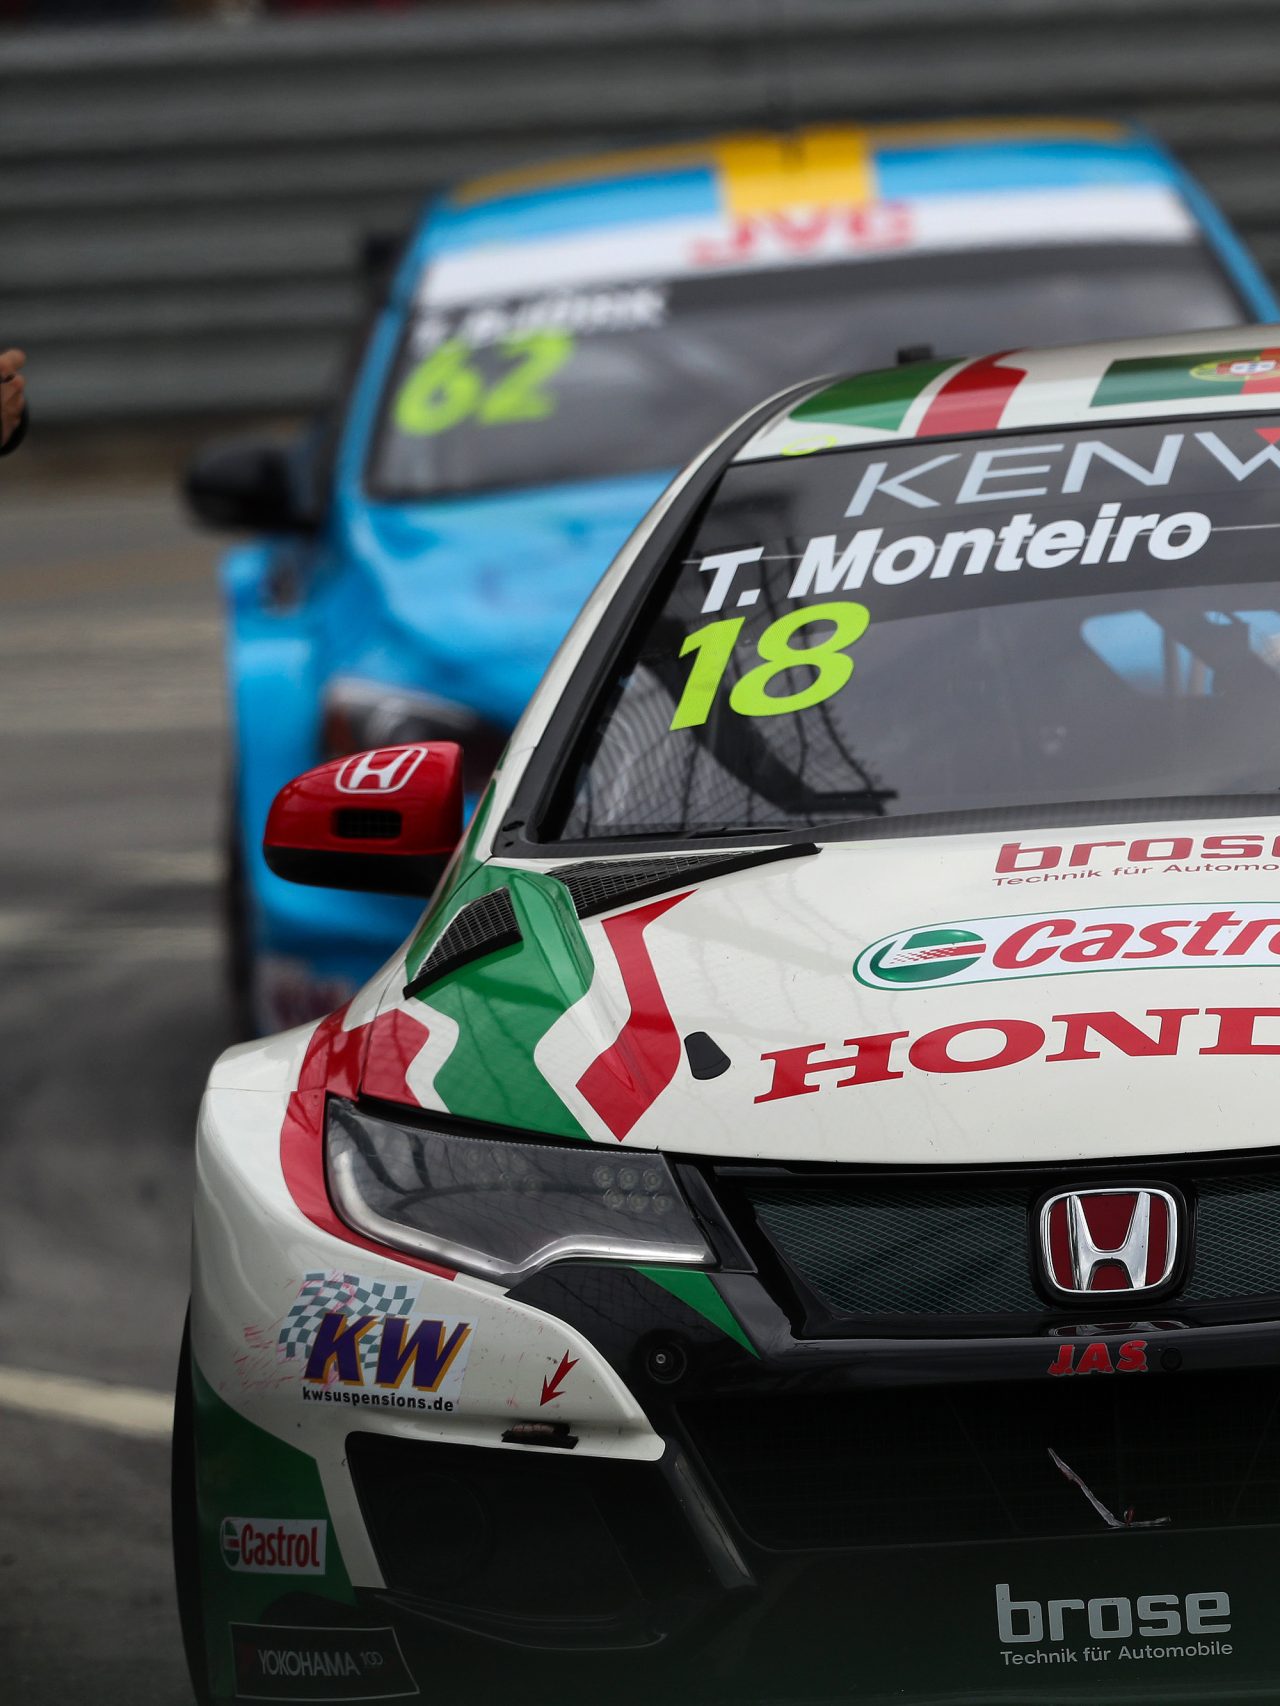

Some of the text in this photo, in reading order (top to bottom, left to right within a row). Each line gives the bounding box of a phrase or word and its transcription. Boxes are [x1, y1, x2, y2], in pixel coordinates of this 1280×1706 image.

[395, 325, 574, 436] 62
[700, 503, 1211, 613] T. Monteiro
[669, 602, 870, 730] 18
[992, 869, 1103, 887] Technik
[1113, 865, 1153, 877] für
[302, 1312, 472, 1393] KW
[302, 1386, 454, 1412] kwsuspensions.de
[240, 1524, 321, 1568] Castrol
[995, 1583, 1231, 1643] brose
[257, 1650, 361, 1677] YOKOHAMA
[1001, 1640, 1233, 1666] Technik für Automobile
